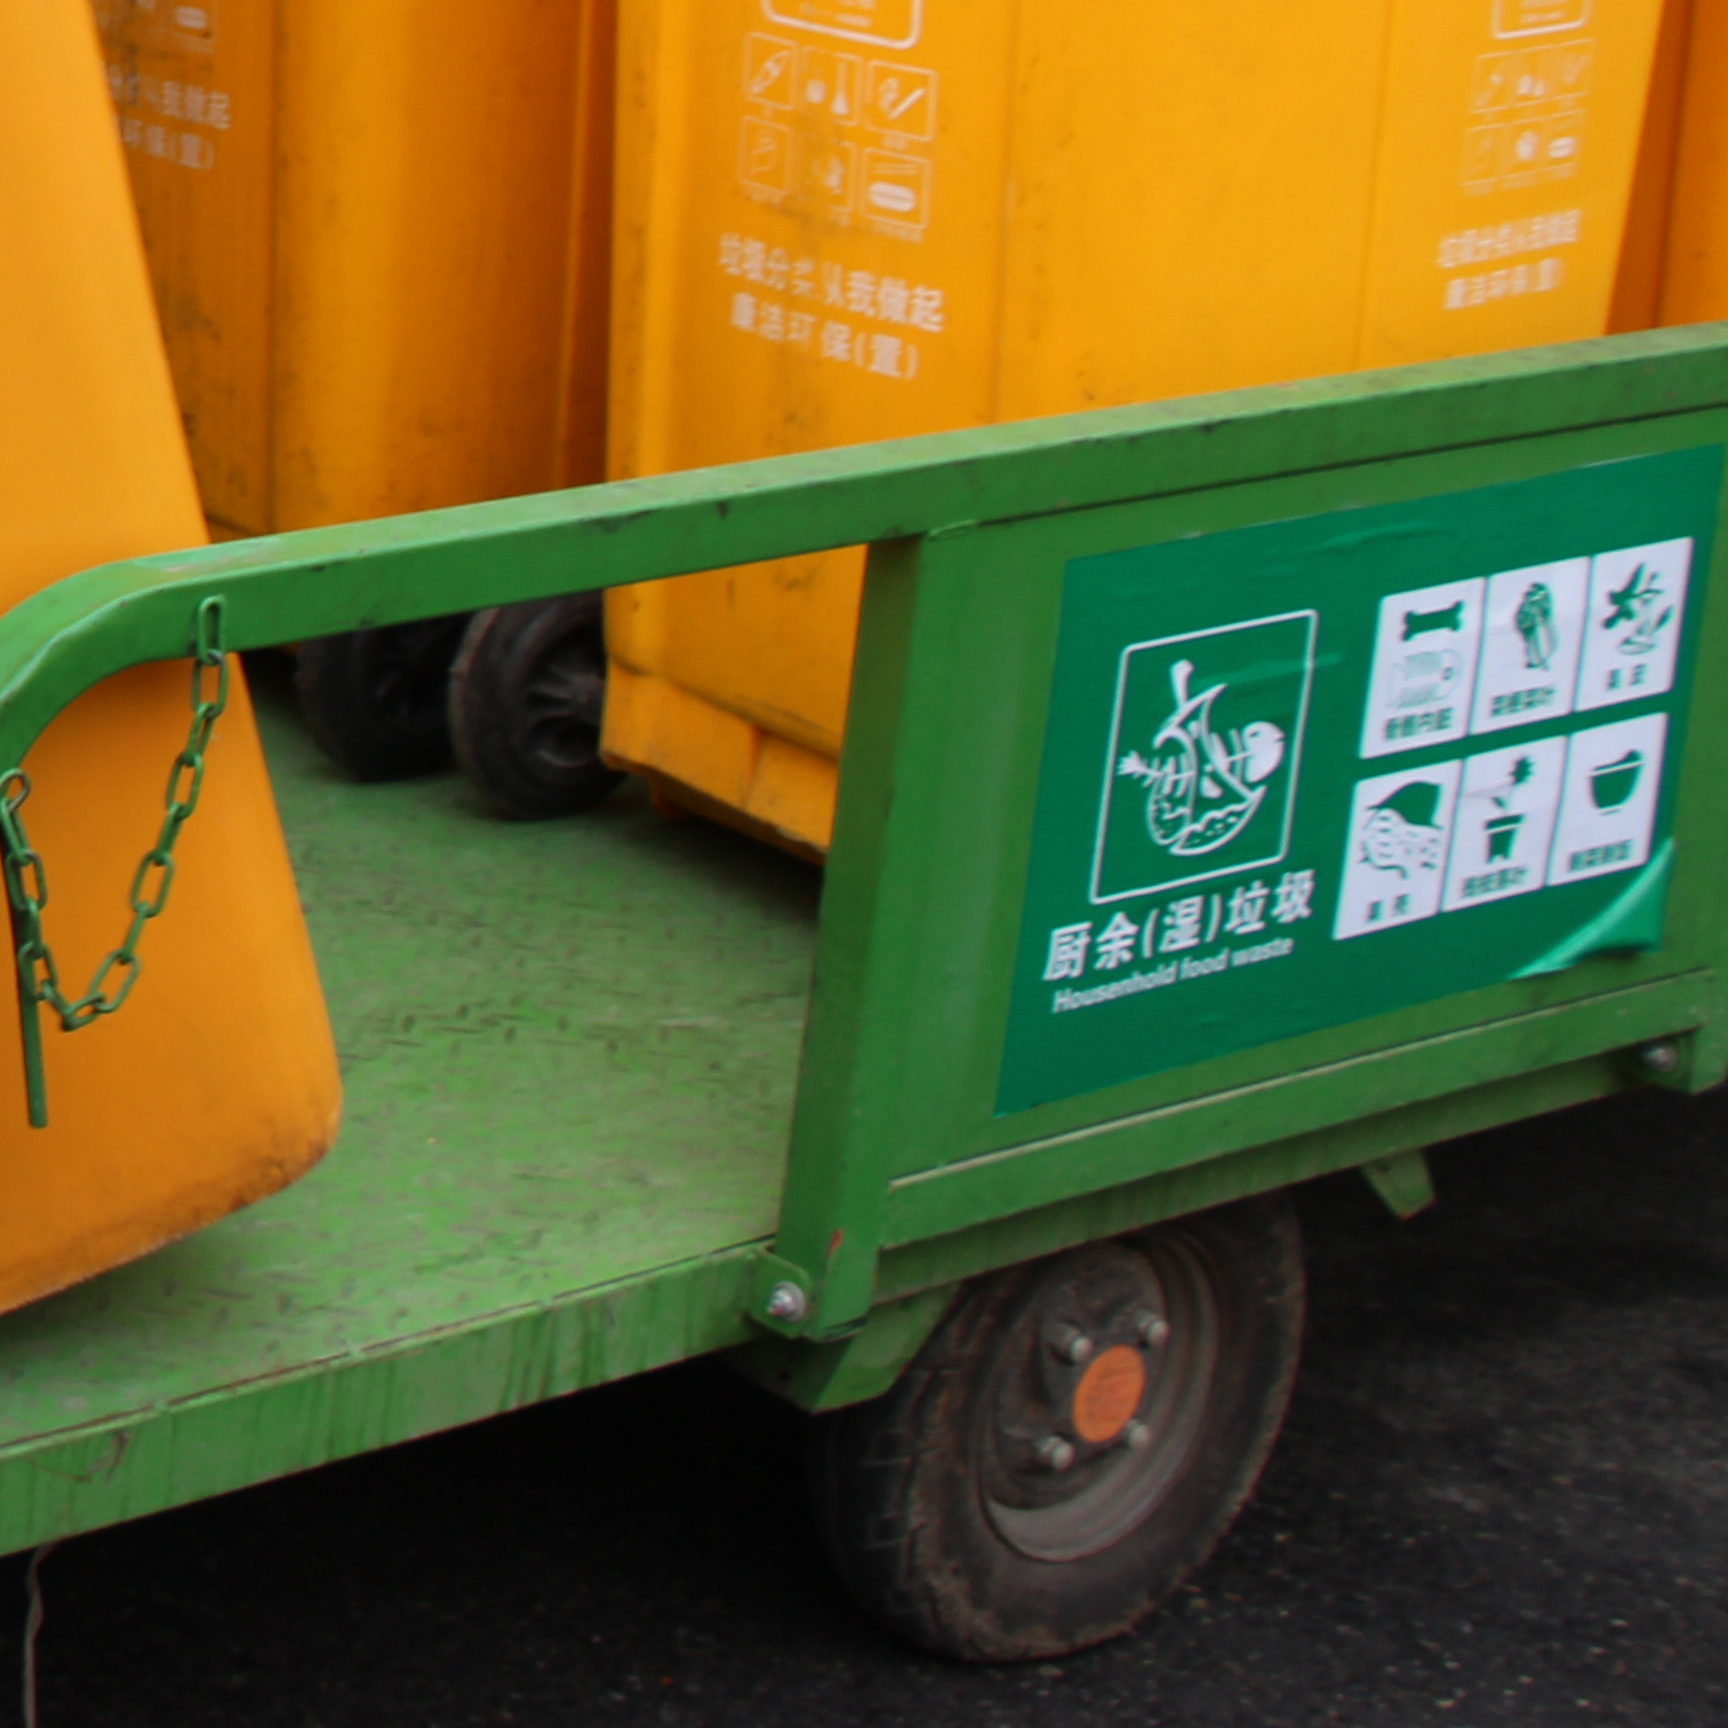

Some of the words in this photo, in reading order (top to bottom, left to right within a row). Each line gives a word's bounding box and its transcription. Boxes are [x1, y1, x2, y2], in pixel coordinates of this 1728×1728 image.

[1043, 869, 1314, 981] 厨余(湿)垃圾
[1178, 947, 1229, 980] food
[1231, 937, 1295, 967] waste
